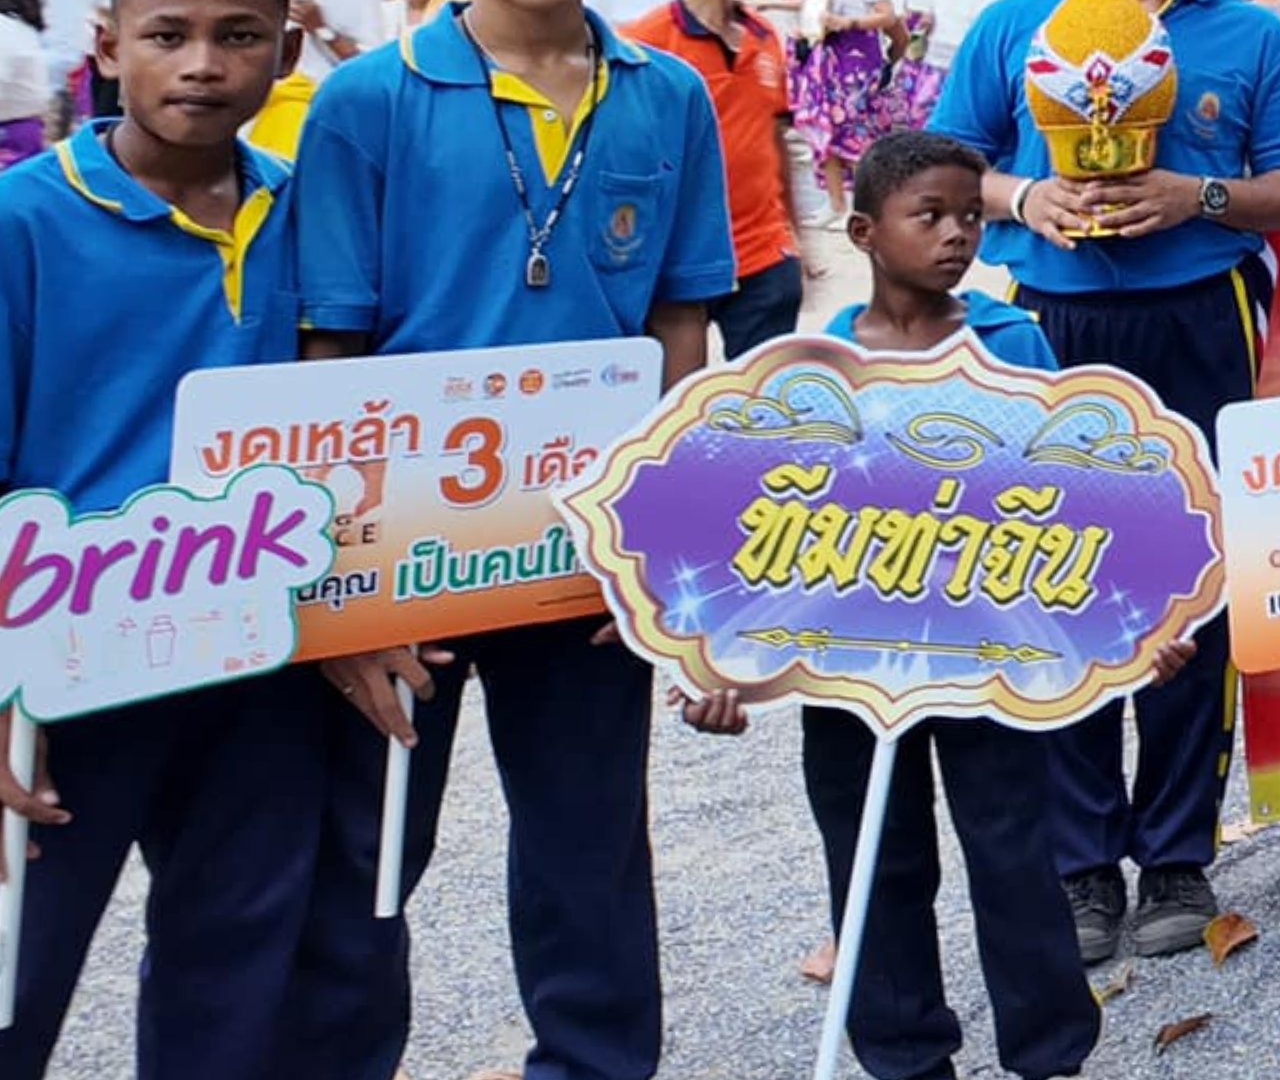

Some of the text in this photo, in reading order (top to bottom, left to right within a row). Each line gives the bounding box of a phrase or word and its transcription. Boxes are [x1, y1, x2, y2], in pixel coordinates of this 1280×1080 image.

[201, 399, 598, 506] งดเหล้า 3 เดือ
[0, 490, 309, 630] brink
[396, 525, 577, 597] เป็นคนใ
[733, 463, 1108, 609] ทีมท่าจีน
